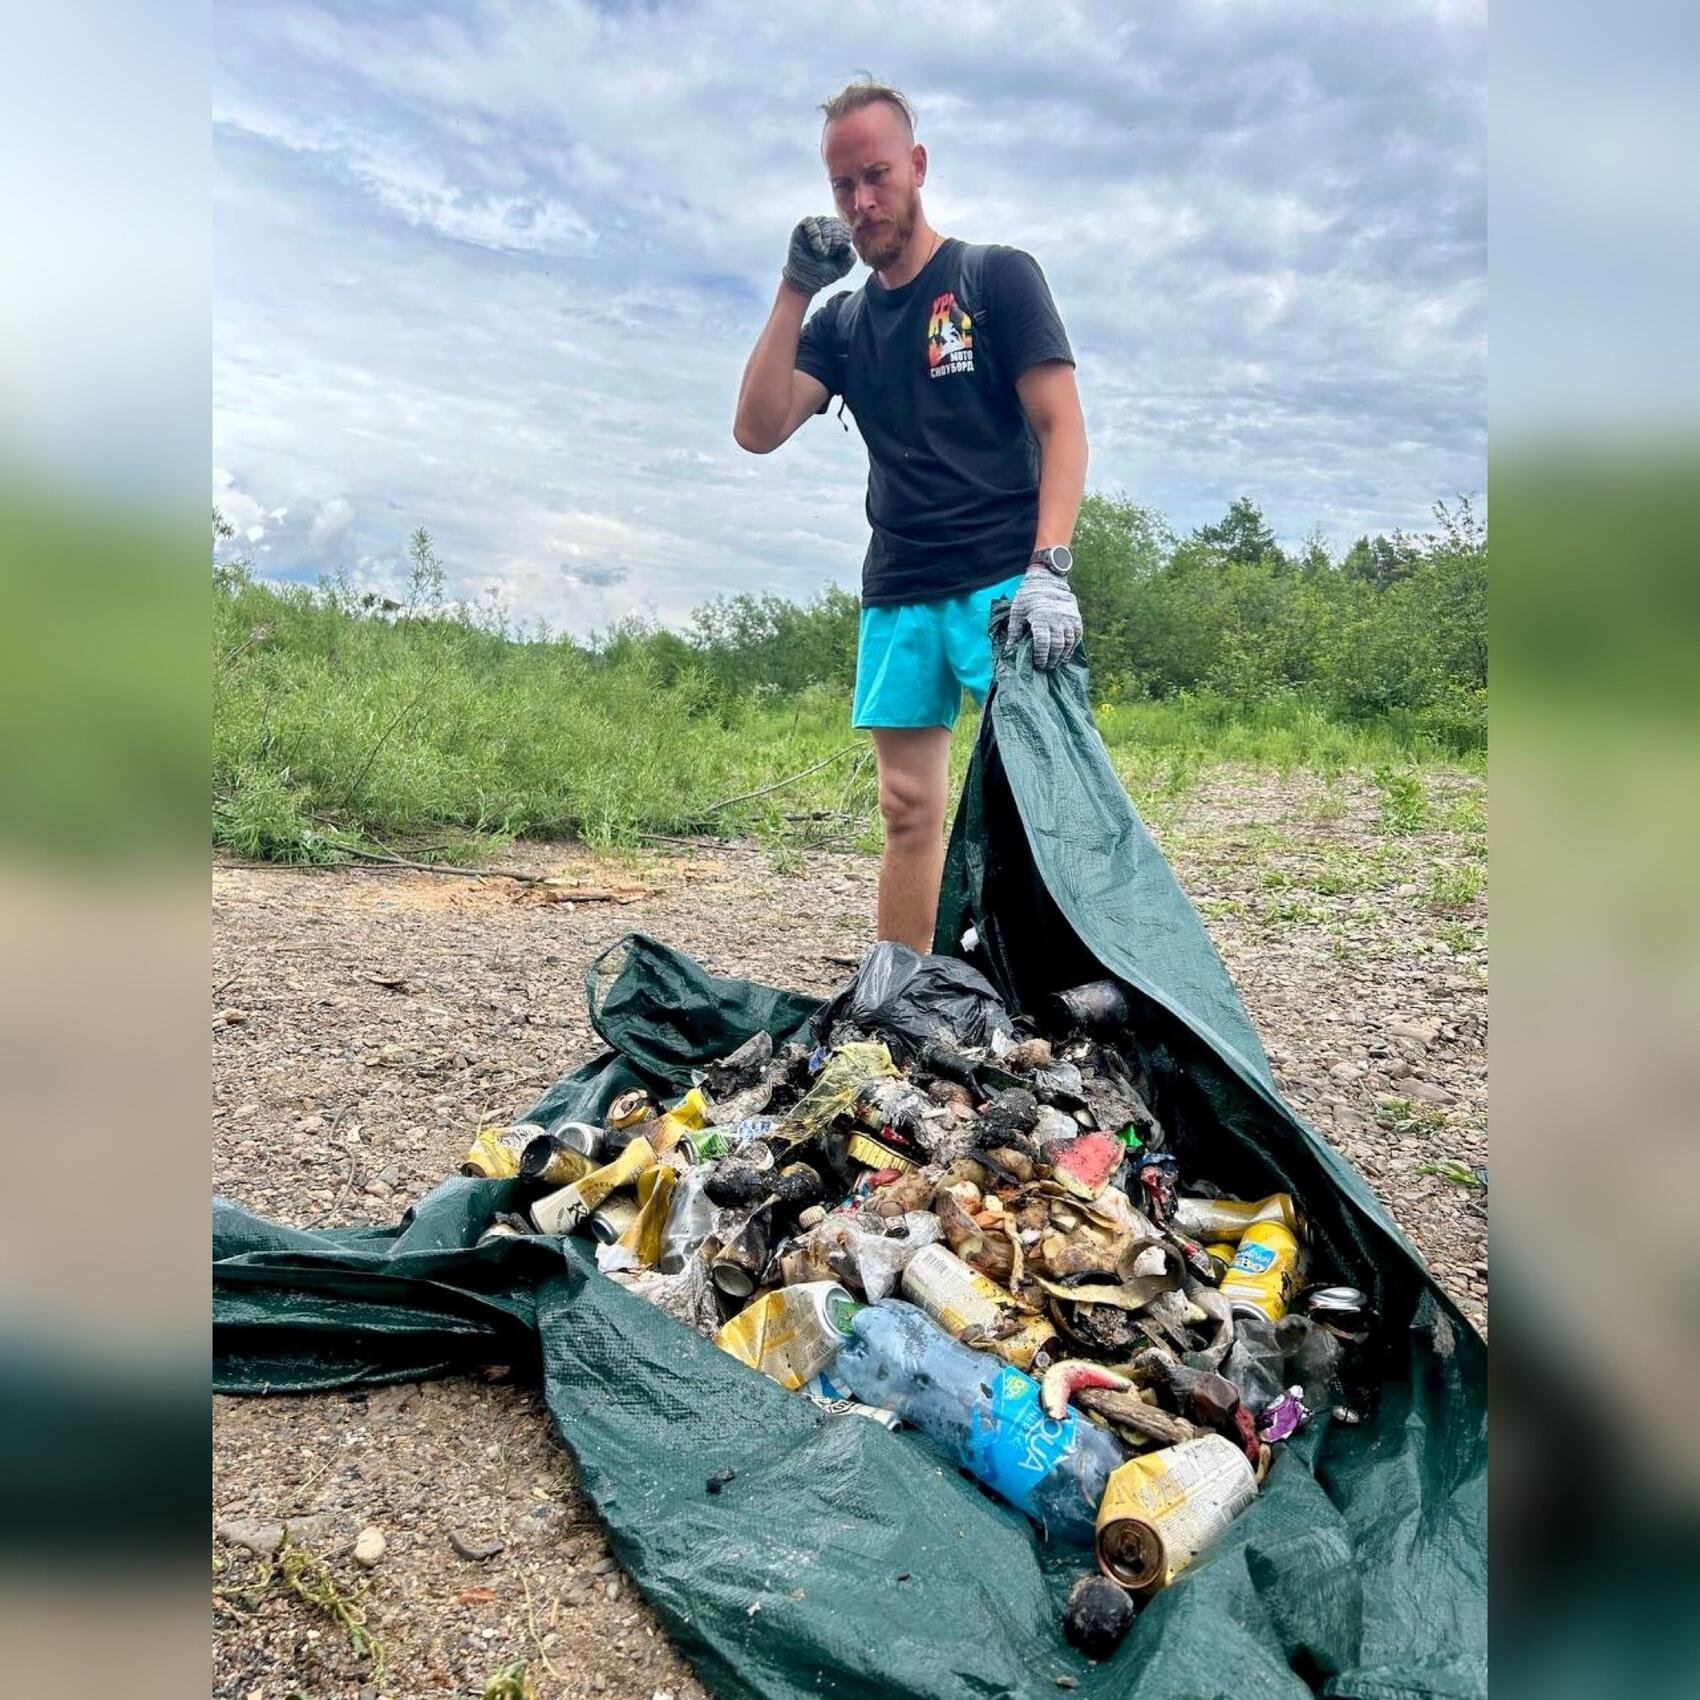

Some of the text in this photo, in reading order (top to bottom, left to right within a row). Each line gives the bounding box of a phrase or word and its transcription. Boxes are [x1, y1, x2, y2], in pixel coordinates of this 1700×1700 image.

[950, 350, 973, 362] МОТО
[930, 362, 974, 378] СНОУБОРД
[1017, 1417, 1067, 1472] QUA
